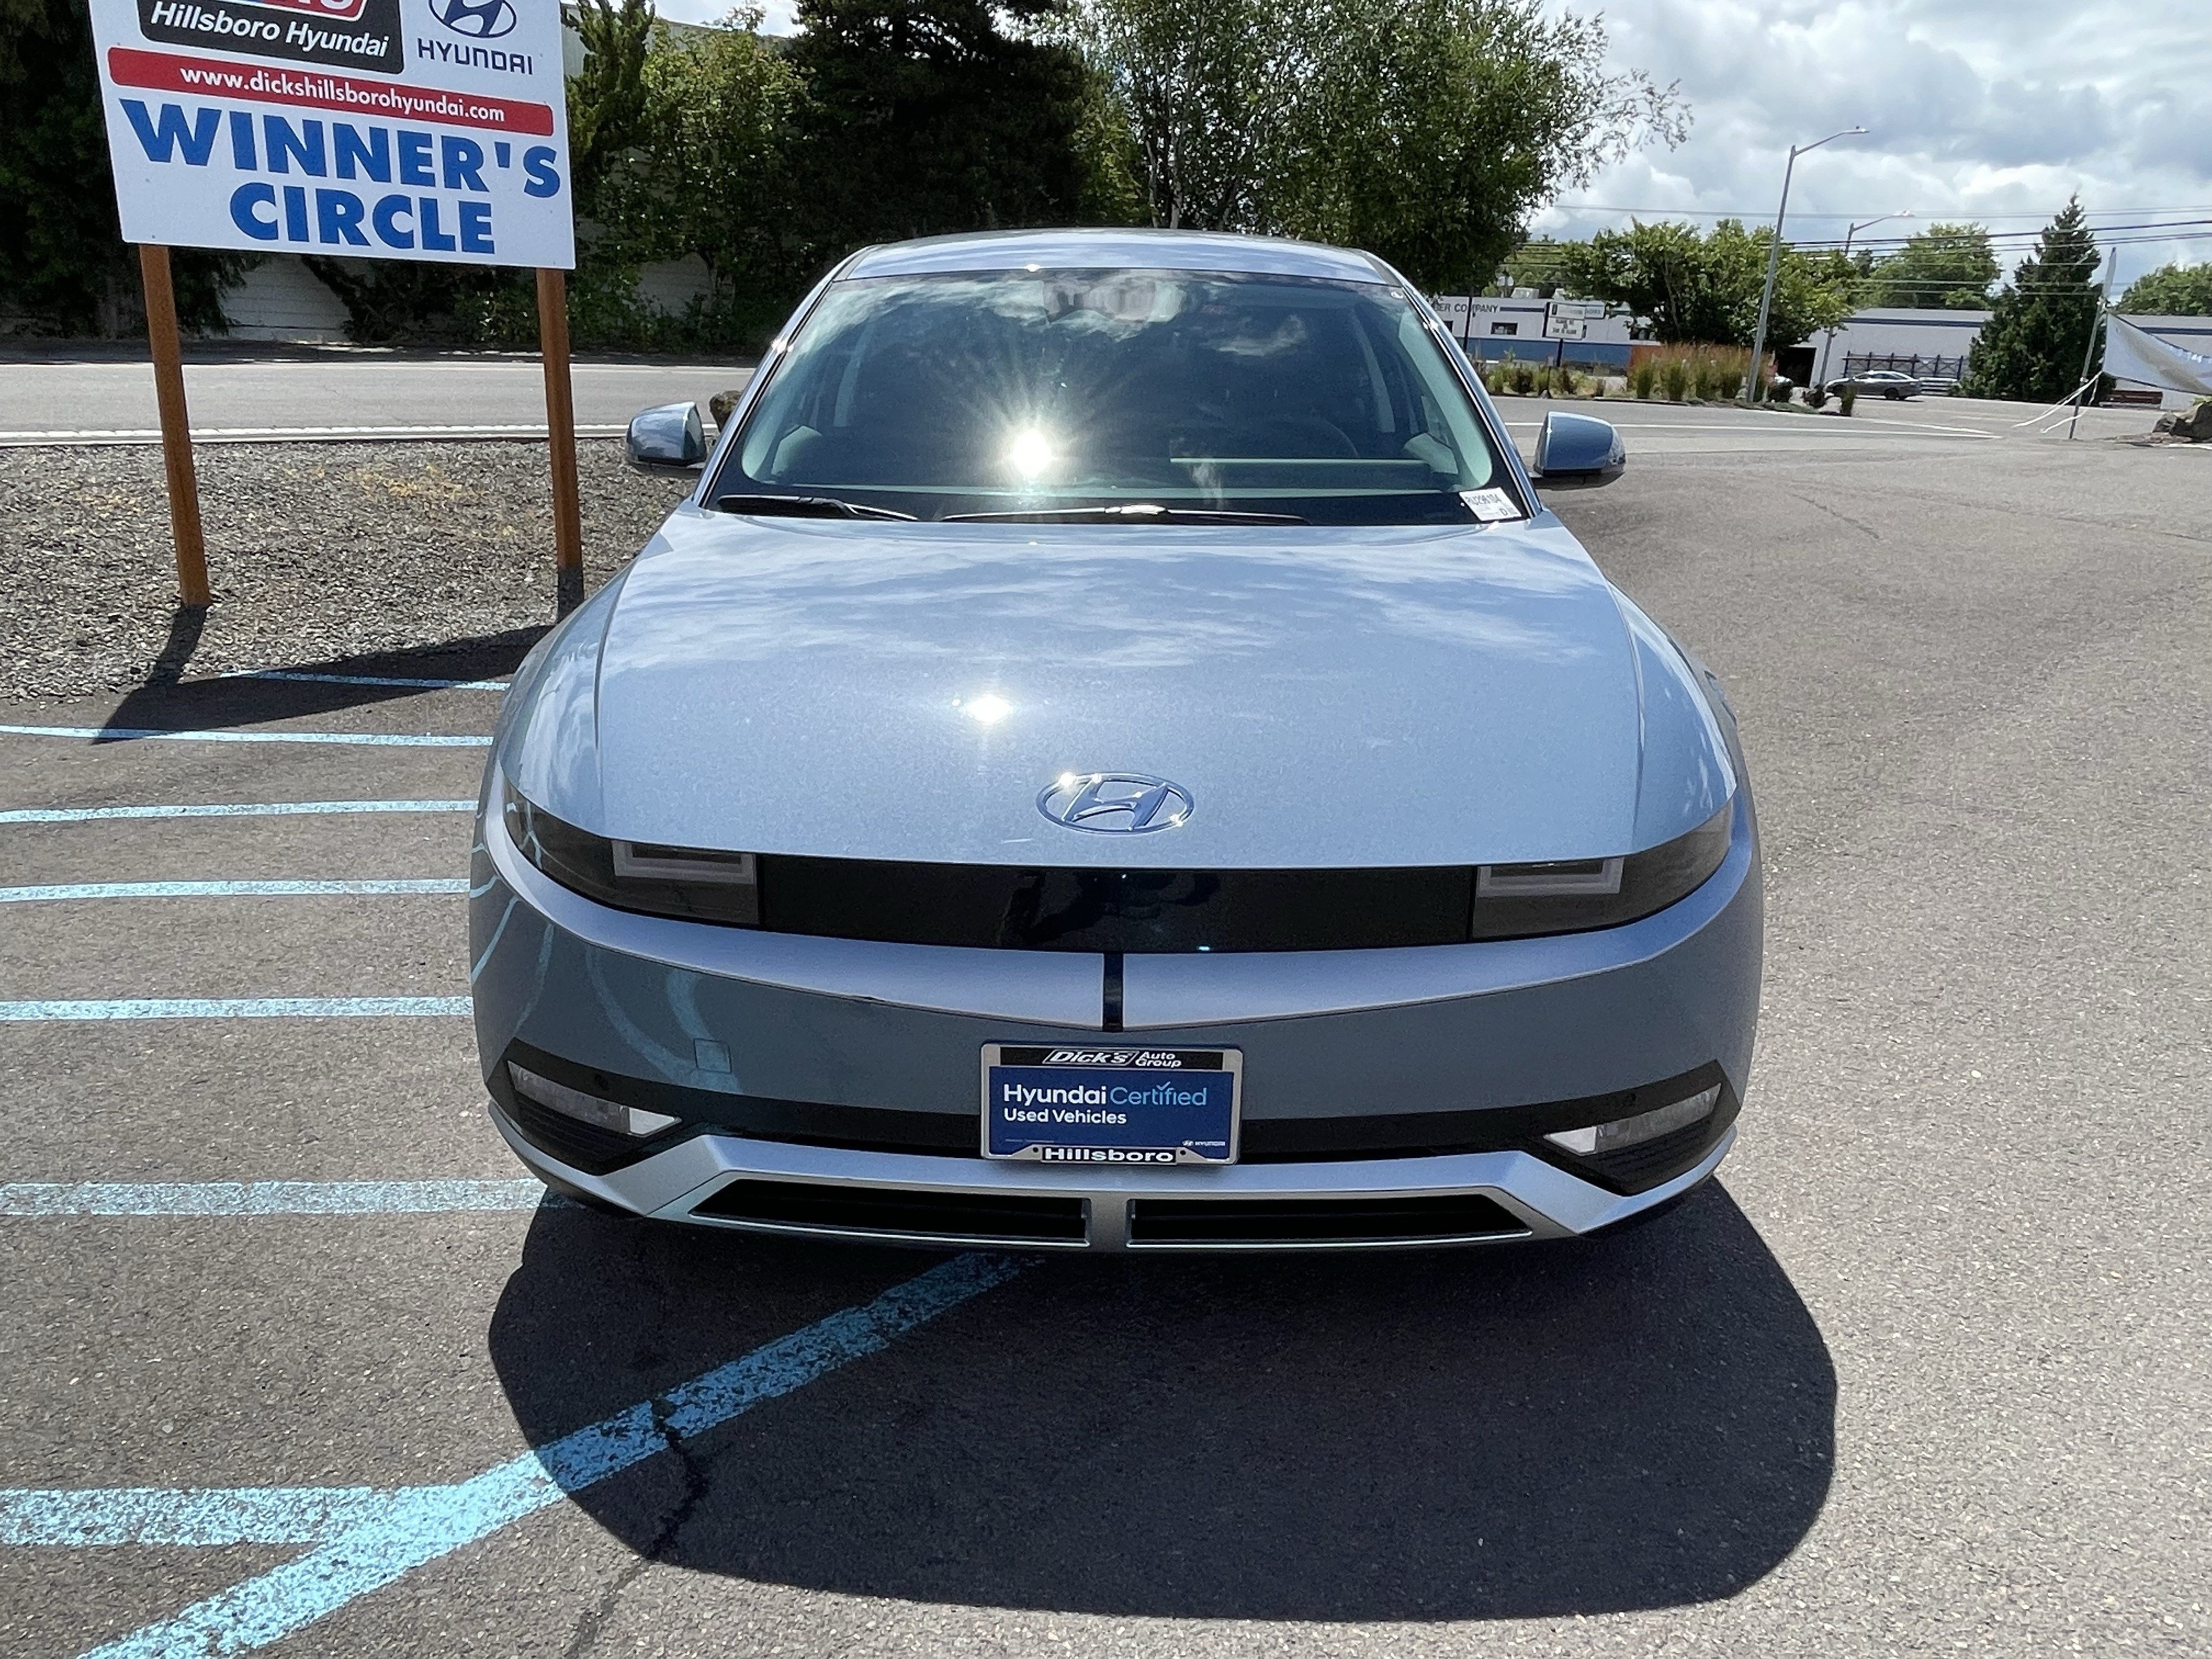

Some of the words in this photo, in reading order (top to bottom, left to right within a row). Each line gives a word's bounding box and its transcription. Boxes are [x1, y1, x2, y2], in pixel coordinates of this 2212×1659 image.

[150, 1, 280, 40] Hillsboro
[285, 21, 388, 57] Hyundai
[417, 38, 533, 75] HYUNDAI
[180, 67, 505, 122] www.dickshillsborohyundai.com
[119, 98, 561, 198] WINNER'S
[229, 182, 496, 255] CIRCLE
[1049, 1051, 1128, 1063] Dick's
[1135, 1059, 1182, 1068] Group
[1143, 1051, 1176, 1059] Auto
[1003, 1084, 1107, 1107] Hyundai
[1109, 1081, 1207, 1106] Certified
[1003, 1108, 1049, 1122] Used
[1052, 1109, 1127, 1124] Vehicles
[1044, 1147, 1173, 1162] Hillsboro
